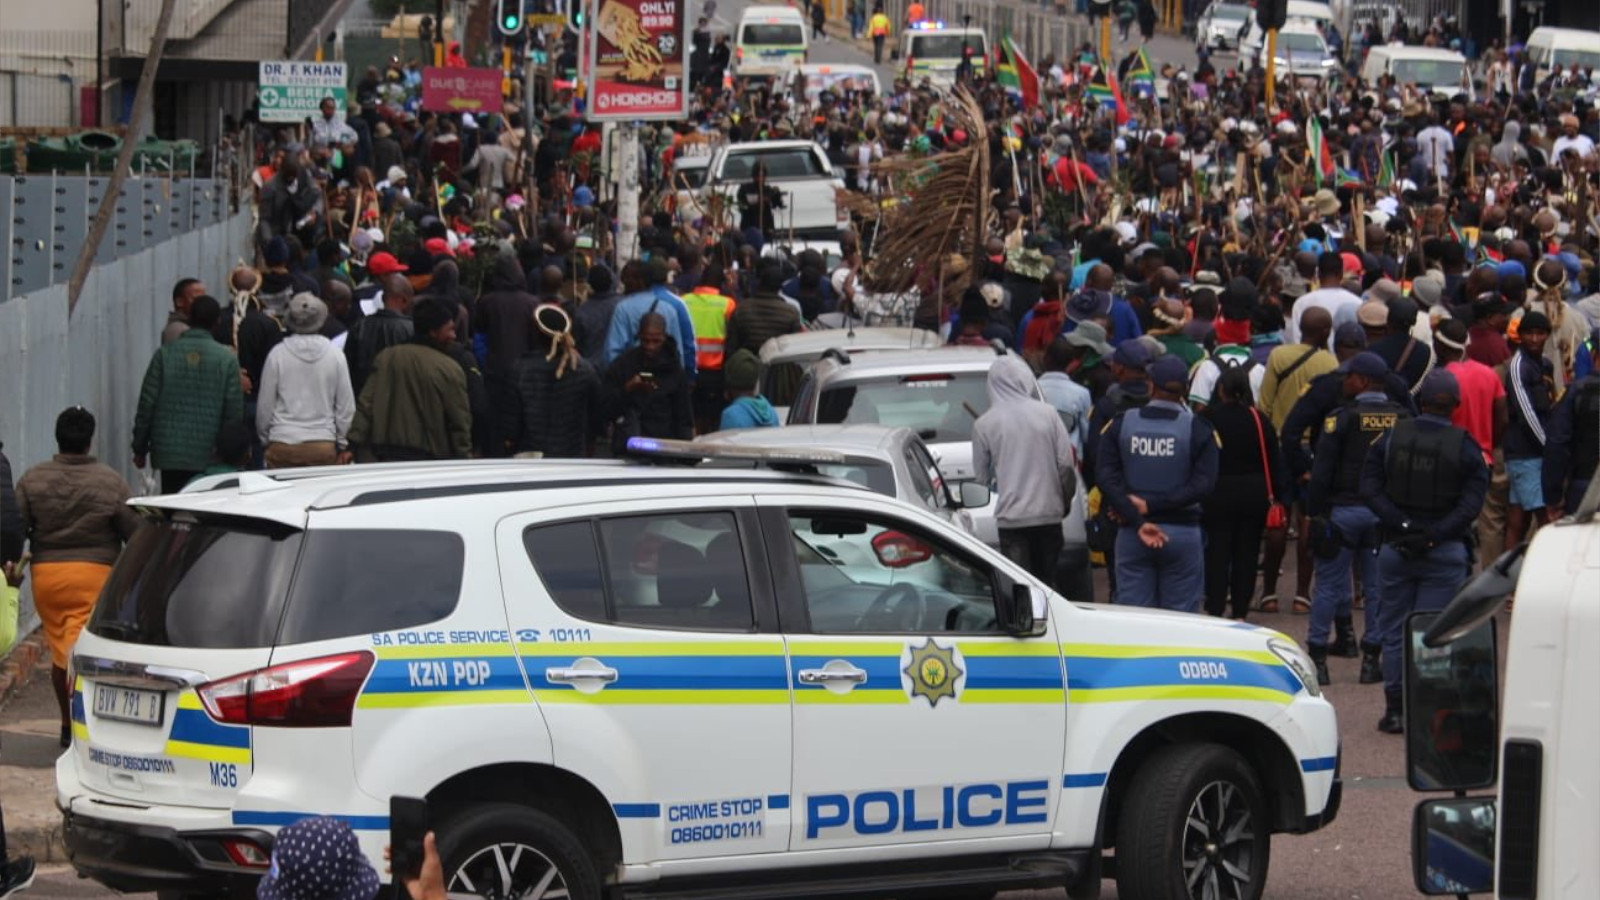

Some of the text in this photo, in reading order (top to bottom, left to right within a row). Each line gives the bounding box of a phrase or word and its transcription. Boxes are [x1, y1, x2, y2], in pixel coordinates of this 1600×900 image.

[640, 2, 675, 14] ONLY!
[264, 63, 286, 76] DR.
[303, 64, 343, 77] KHAN
[286, 87, 335, 99] BEREA
[611, 91, 676, 107] HONCHOS
[279, 97, 343, 110] SURGY
[1362, 416, 1398, 428] POLICE
[1131, 436, 1175, 457] POLICE
[372, 628, 591, 646] SA POLICE SERVICE 10111
[408, 660, 491, 687] KZN POP
[98, 688, 118, 712] BVW
[123, 690, 139, 717] 791
[104, 751, 122, 769] STOP
[209, 761, 238, 788] M36
[668, 798, 762, 822] CRIME STOP
[807, 779, 1049, 839] POLICE
[671, 820, 762, 844] 0860010111
